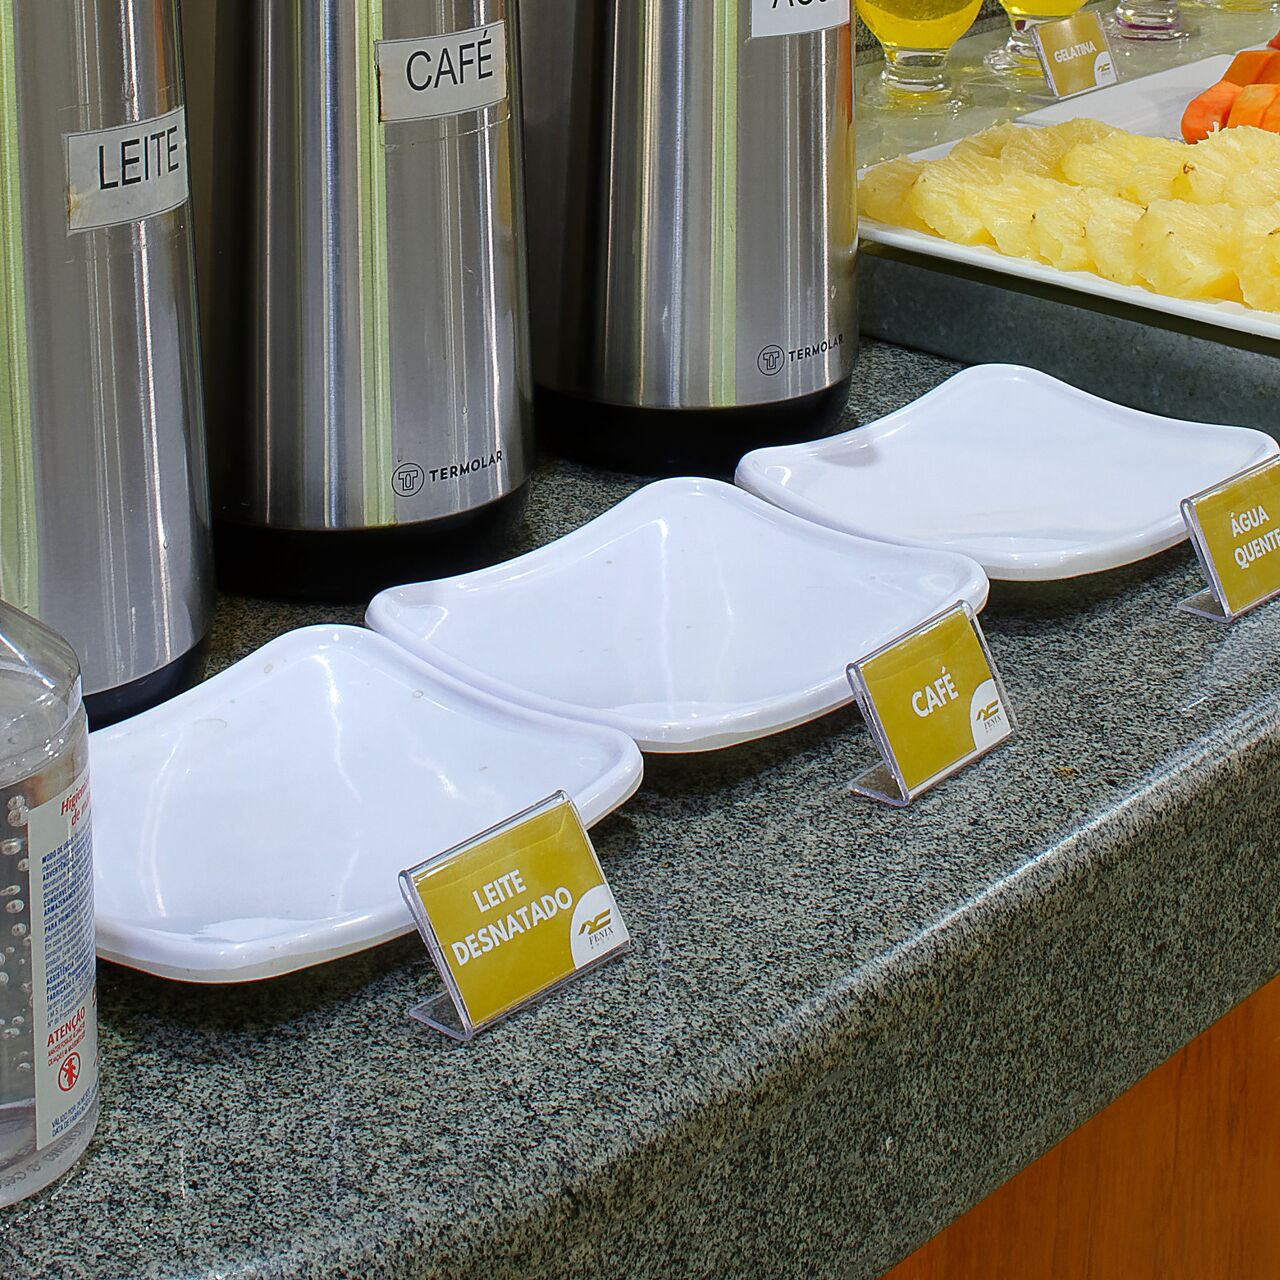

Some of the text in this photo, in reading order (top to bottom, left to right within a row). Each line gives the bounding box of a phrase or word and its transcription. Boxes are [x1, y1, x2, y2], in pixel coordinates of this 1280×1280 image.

[406, 30, 493, 91] CAFÉ
[1053, 41, 1097, 63] GELATINA
[99, 125, 179, 190] LEITE
[789, 334, 843, 362] TERMOLAR
[429, 450, 503, 482] TERMOLAR
[1230, 505, 1270, 537] ÁGUA
[911, 666, 959, 718] CAFÉ
[472, 869, 527, 913] LEITE
[451, 886, 573, 966] DESNATADO
[48, 1006, 85, 1047] ATENÇÃO
